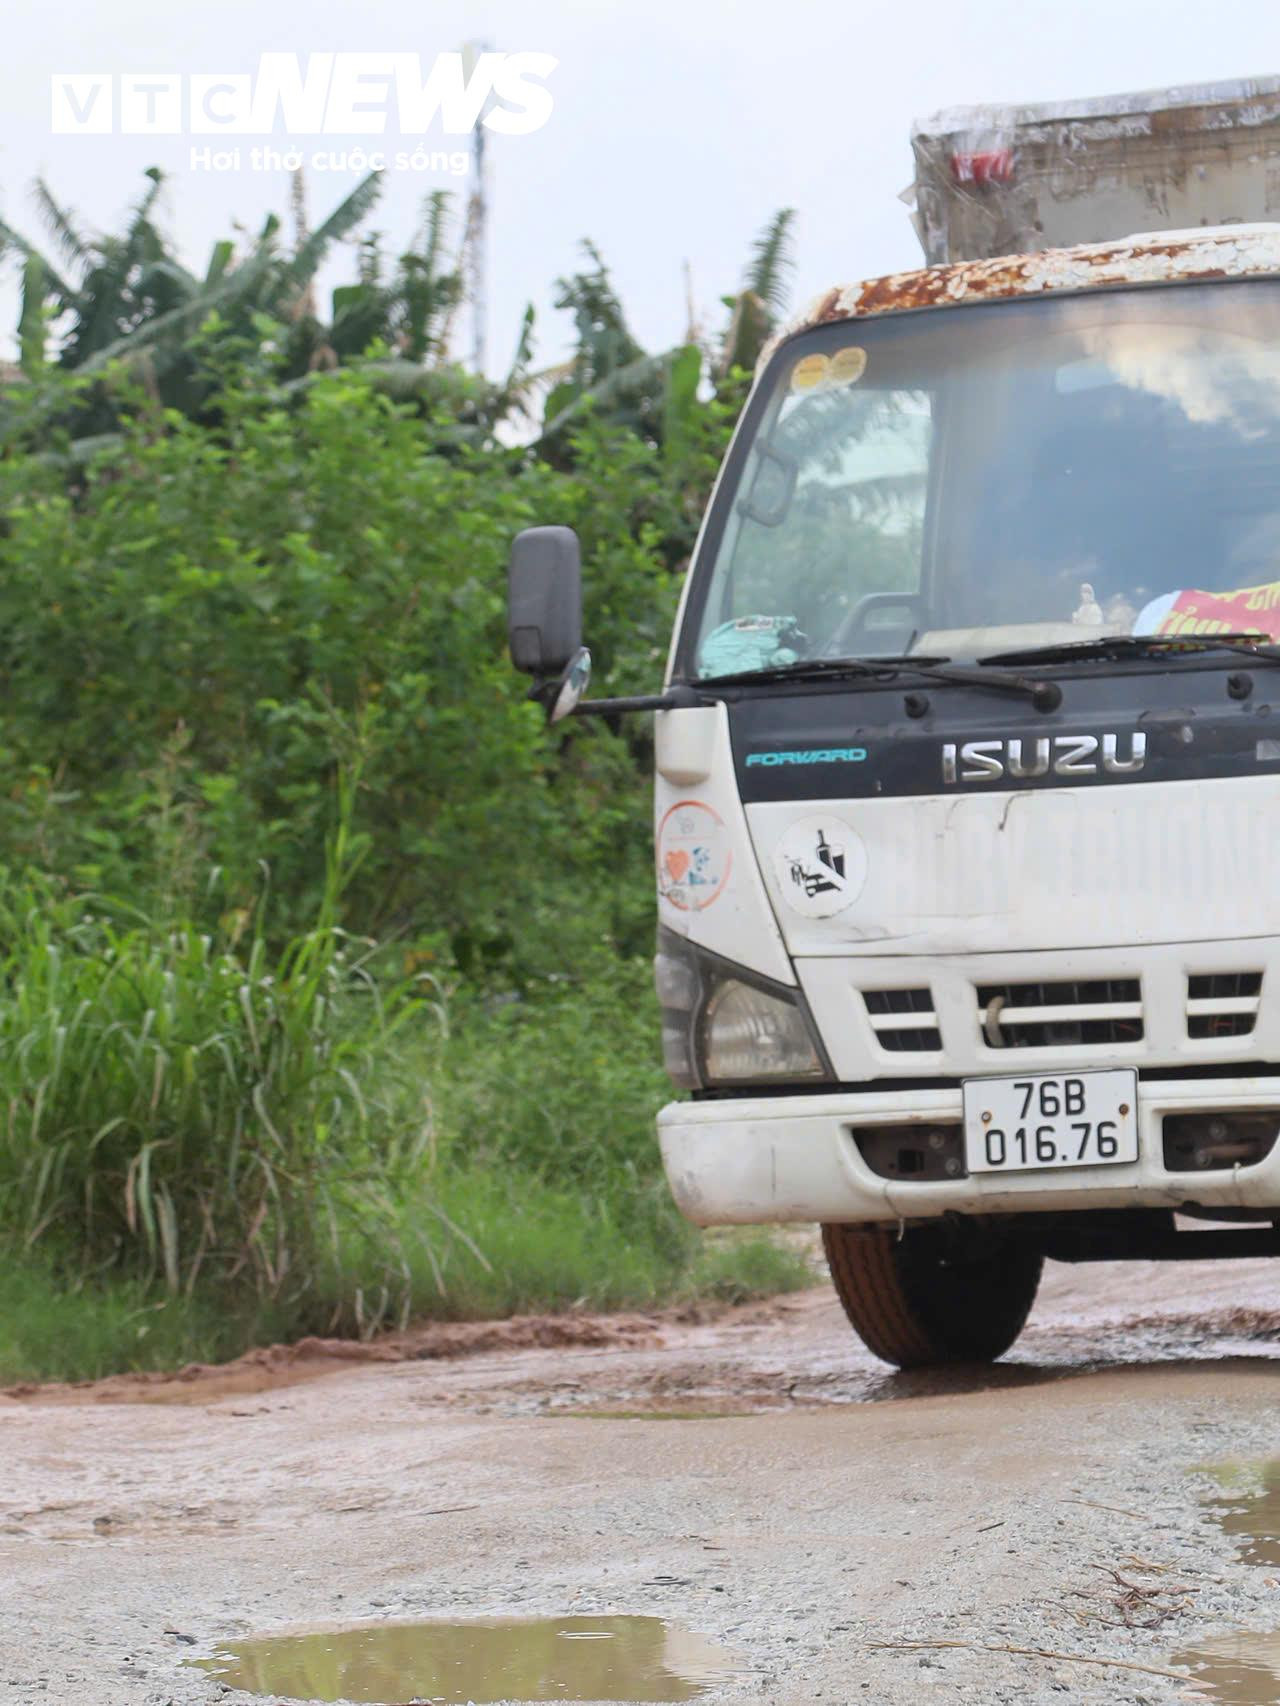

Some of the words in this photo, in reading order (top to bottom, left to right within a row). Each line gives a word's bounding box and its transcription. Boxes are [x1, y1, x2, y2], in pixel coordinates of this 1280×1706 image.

[745, 747, 868, 768] FORWARD
[942, 732, 1147, 785] ISUZU
[1013, 1079, 1086, 1120] 76B
[985, 1121, 1118, 1166] 016.76
